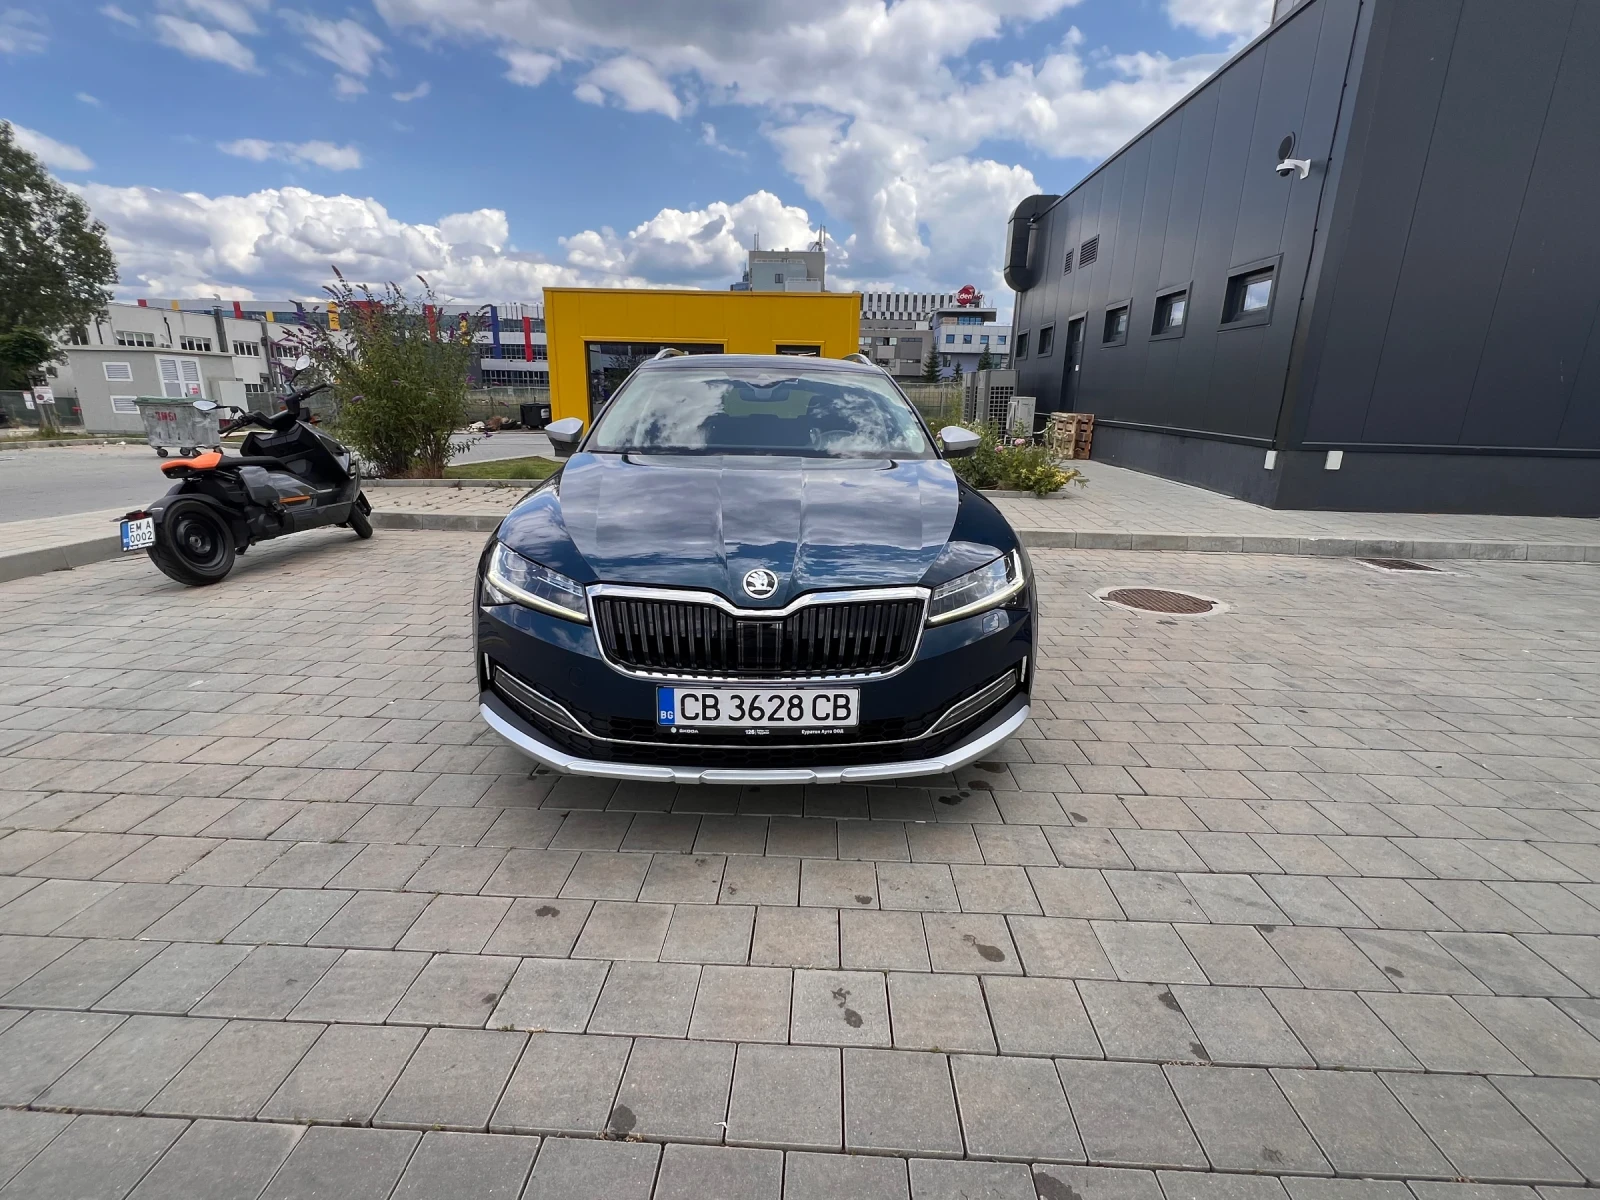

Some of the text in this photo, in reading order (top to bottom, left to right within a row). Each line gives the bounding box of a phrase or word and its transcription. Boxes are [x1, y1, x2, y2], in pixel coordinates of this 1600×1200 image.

[130, 520, 151, 533] EM A
[130, 531, 152, 543] 0002
[680, 693, 852, 721] CB 3628 CB
[660, 711, 674, 719] BG
